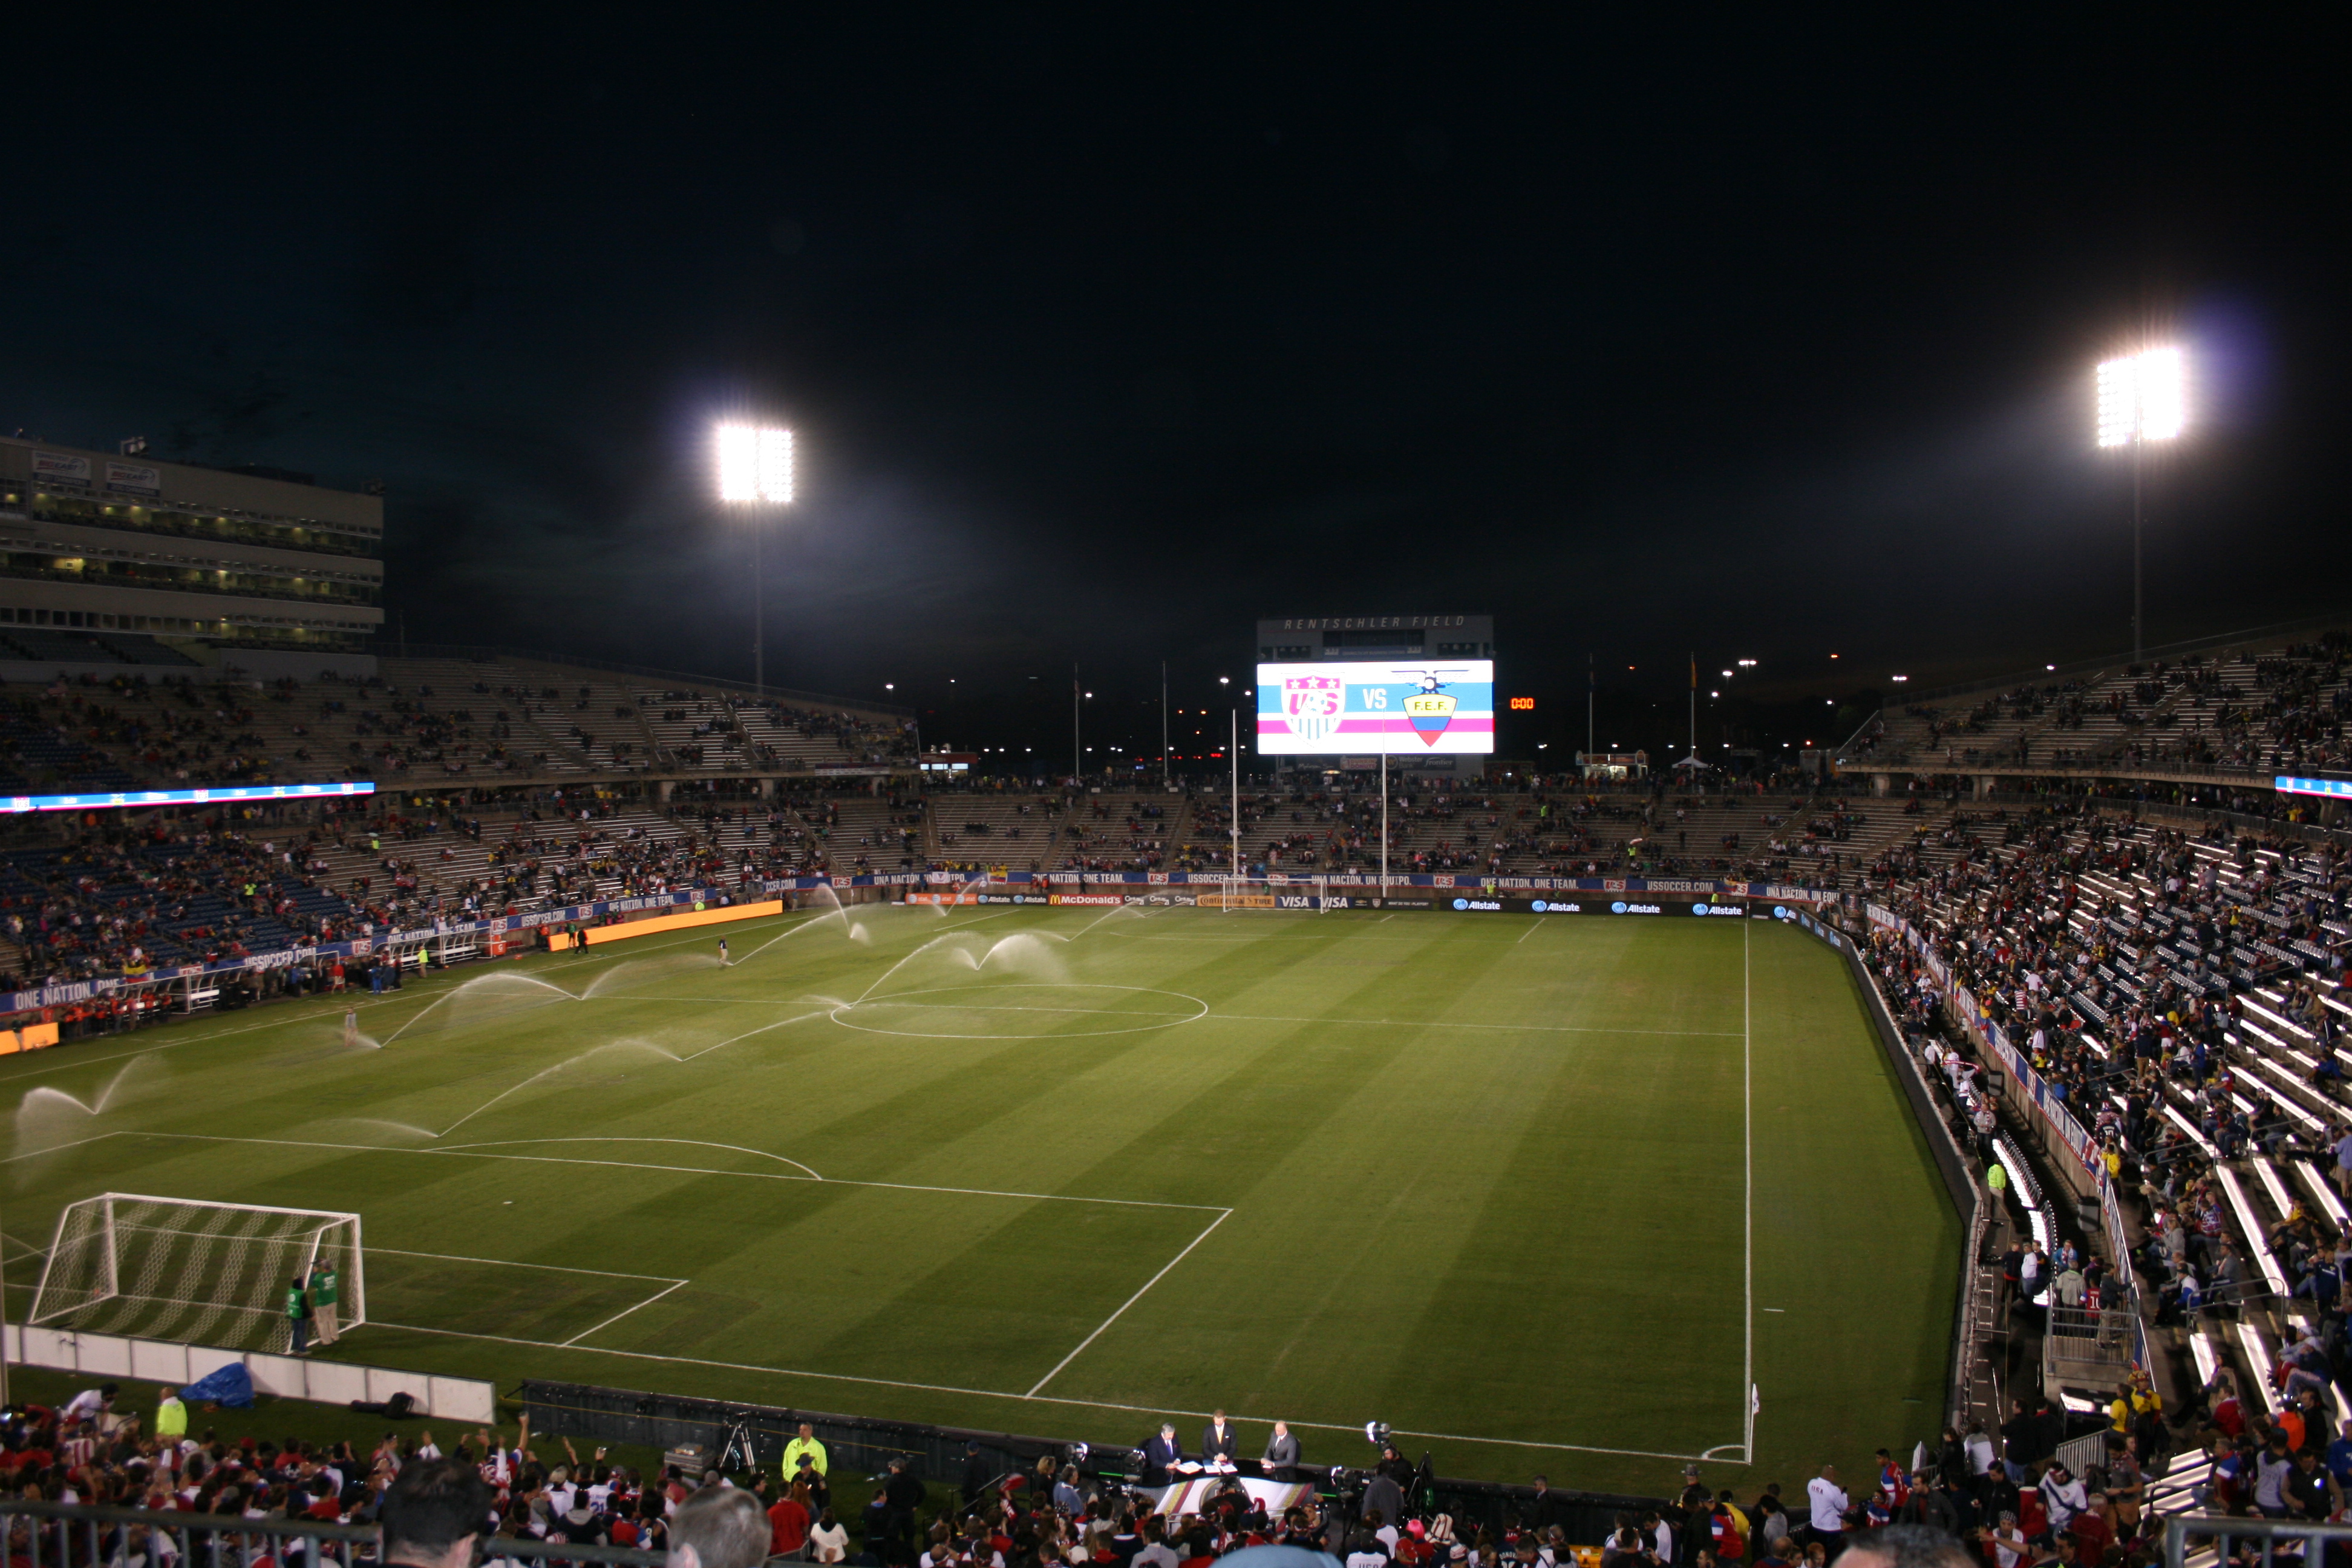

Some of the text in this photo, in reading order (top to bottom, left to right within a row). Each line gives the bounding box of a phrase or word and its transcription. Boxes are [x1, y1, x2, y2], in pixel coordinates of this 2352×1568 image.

[54, 462, 78, 471] EAST
[126, 472, 149, 481] EAST
[1284, 615, 1465, 630] RENTSCHLER FIELD
[1362, 688, 1387, 710] VS
[1511, 698, 1534, 709] 0:00
[1414, 701, 1447, 711] F.E.F.
[1424, 757, 1454, 767] frontier
[832, 877, 851, 886] US
[874, 875, 889, 886] UNA
[1032, 873, 1125, 883] ONE NATION. ONE TEAM.
[1149, 873, 1168, 883] US
[1311, 875, 1328, 885] UNA
[1329, 874, 1364, 886] NACIÓN.
[1365, 875, 1378, 885] UN
[1434, 877, 1454, 886] US
[1480, 878, 1579, 889] ONE NATION. ONE TEAM.
[1604, 881, 1624, 890] US
[1647, 881, 1713, 892] USSOCCER.COM
[691, 891, 704, 901] US
[1766, 886, 1780, 898] UNA
[1781, 887, 1810, 900] NACIÓN.
[1811, 890, 1821, 901] UN
[609, 895, 675, 912] ONE NATION. ONE TEAM.
[1061, 895, 1121, 904] McDonald's
[1200, 896, 1245, 906] Continental
[1279, 897, 1310, 907] VISA
[1319, 897, 1349, 908] VISA
[1468, 901, 1501, 910] Allstate
[1547, 903, 1581, 912] Allstate
[1627, 904, 1661, 913] Allstate
[1708, 906, 1743, 915] Allstate
[580, 906, 592, 917] US
[521, 910, 566, 927] USSOCCER.COM
[493, 919, 506, 931] US
[354, 941, 372, 954] US
[15, 991, 41, 1011] ONE
[44, 981, 95, 1007] NATION.
[1811, 1485, 1824, 1494] USA
[590, 1501, 604, 1514] 21
